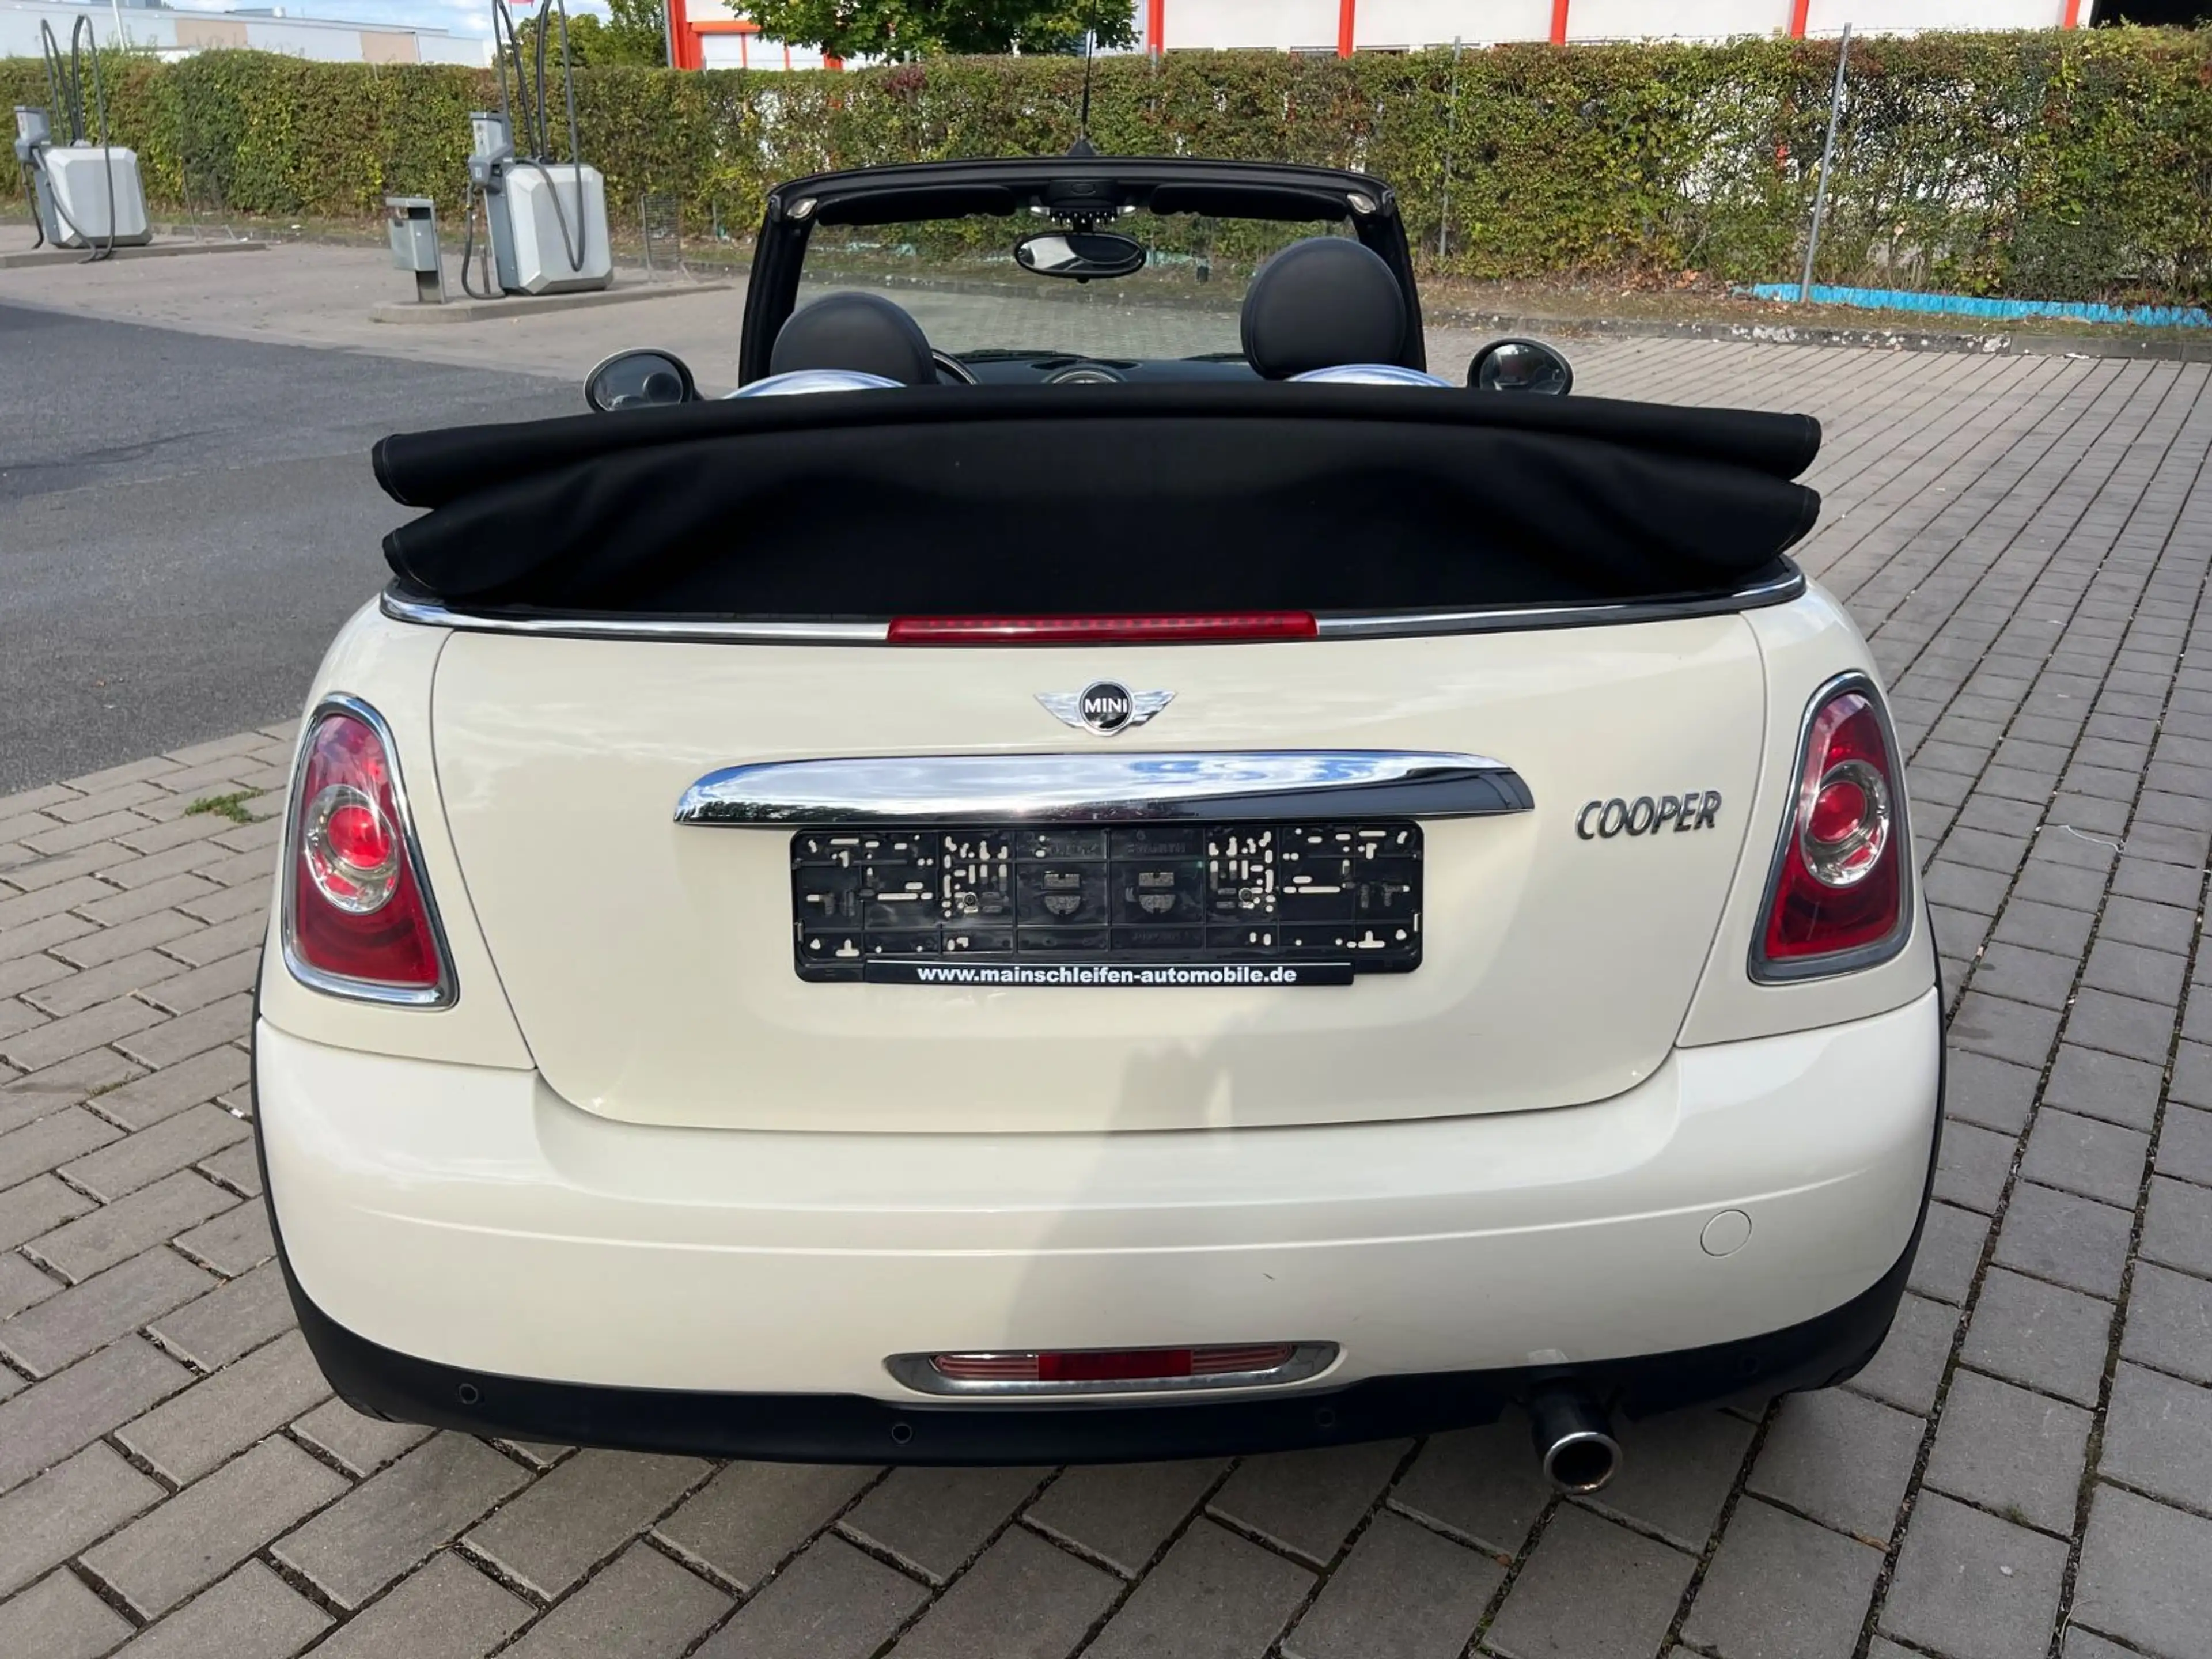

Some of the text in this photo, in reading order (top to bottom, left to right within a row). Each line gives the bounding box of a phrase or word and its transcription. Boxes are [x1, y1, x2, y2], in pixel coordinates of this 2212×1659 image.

[1084, 698, 1128, 713] MINI
[1575, 790, 1722, 840] COOPER
[917, 966, 1297, 983] www.mainschleifen-automobile.de
